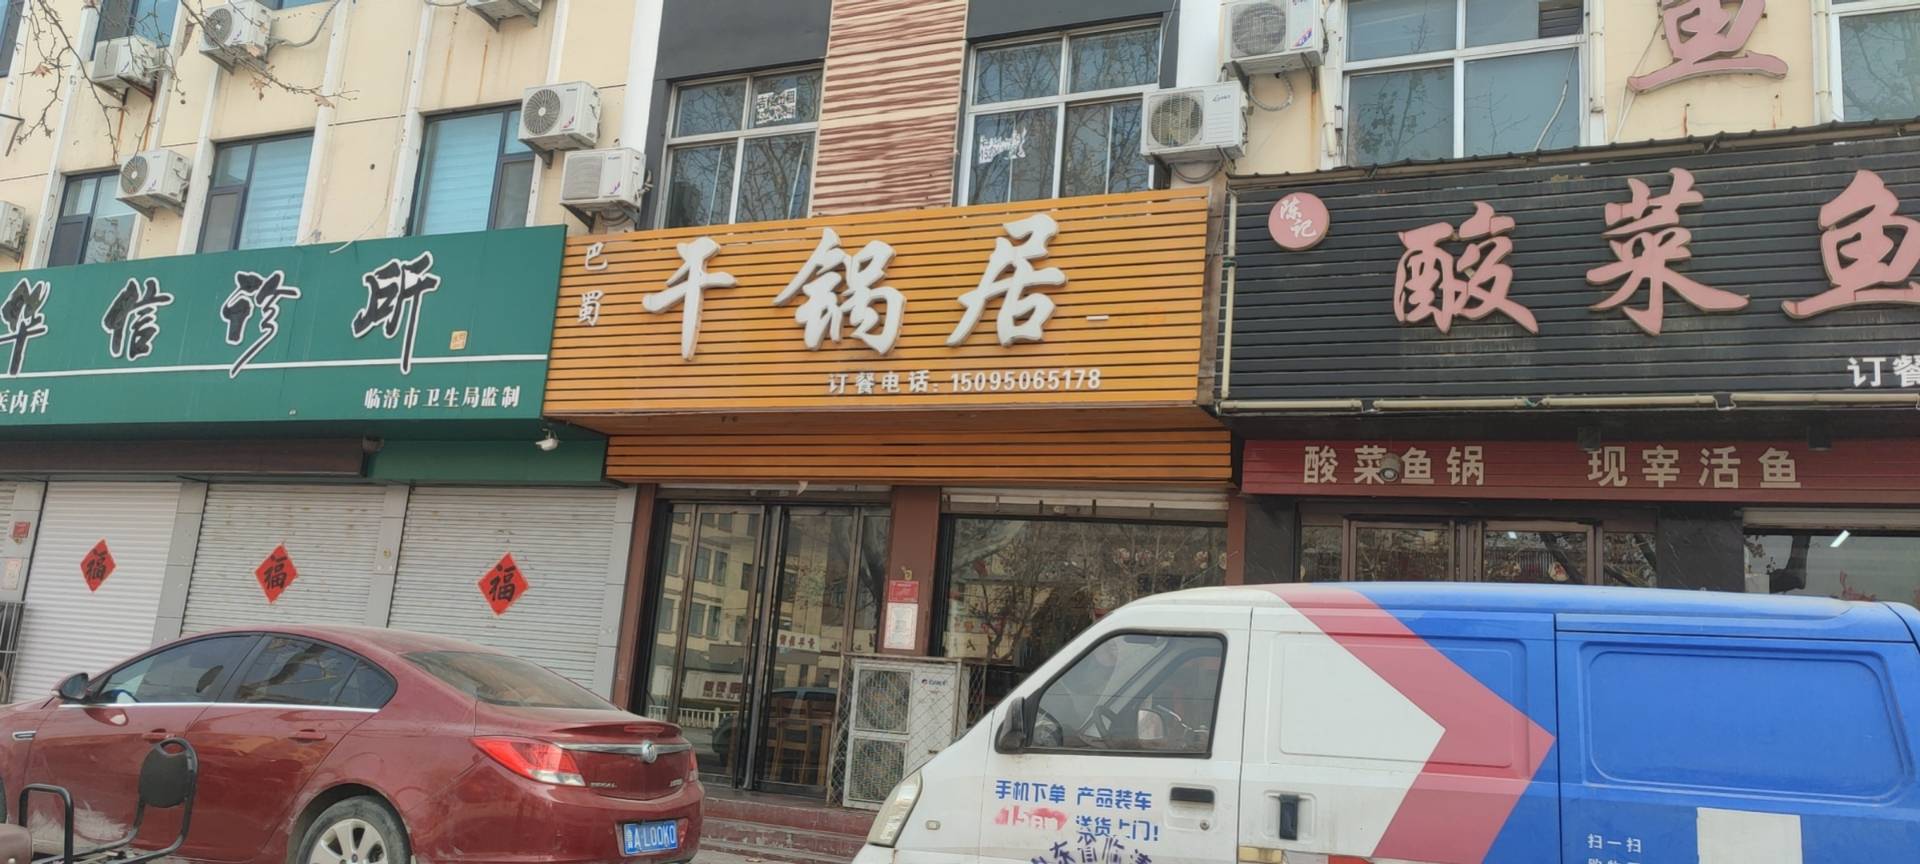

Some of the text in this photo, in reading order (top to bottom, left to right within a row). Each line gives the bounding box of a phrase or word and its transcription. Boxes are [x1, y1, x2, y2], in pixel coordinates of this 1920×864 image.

[1393, 167, 1920, 337] 酸菜鱼
[578, 242, 608, 326] 巴蜀
[642, 213, 1068, 361] 干锅居
[0, 251, 441, 377] 华信诊所
[364, 384, 521, 409] 临清市卫生局监制
[1303, 444, 1801, 489] 酸菜鱼锅 现宰活鱼
[86, 547, 108, 580] 福
[263, 554, 288, 590] 福
[489, 563, 517, 602] 福
[995, 780, 1153, 811] 手机下单 产品装车
[1587, 833, 1642, 853] 扫一扫
